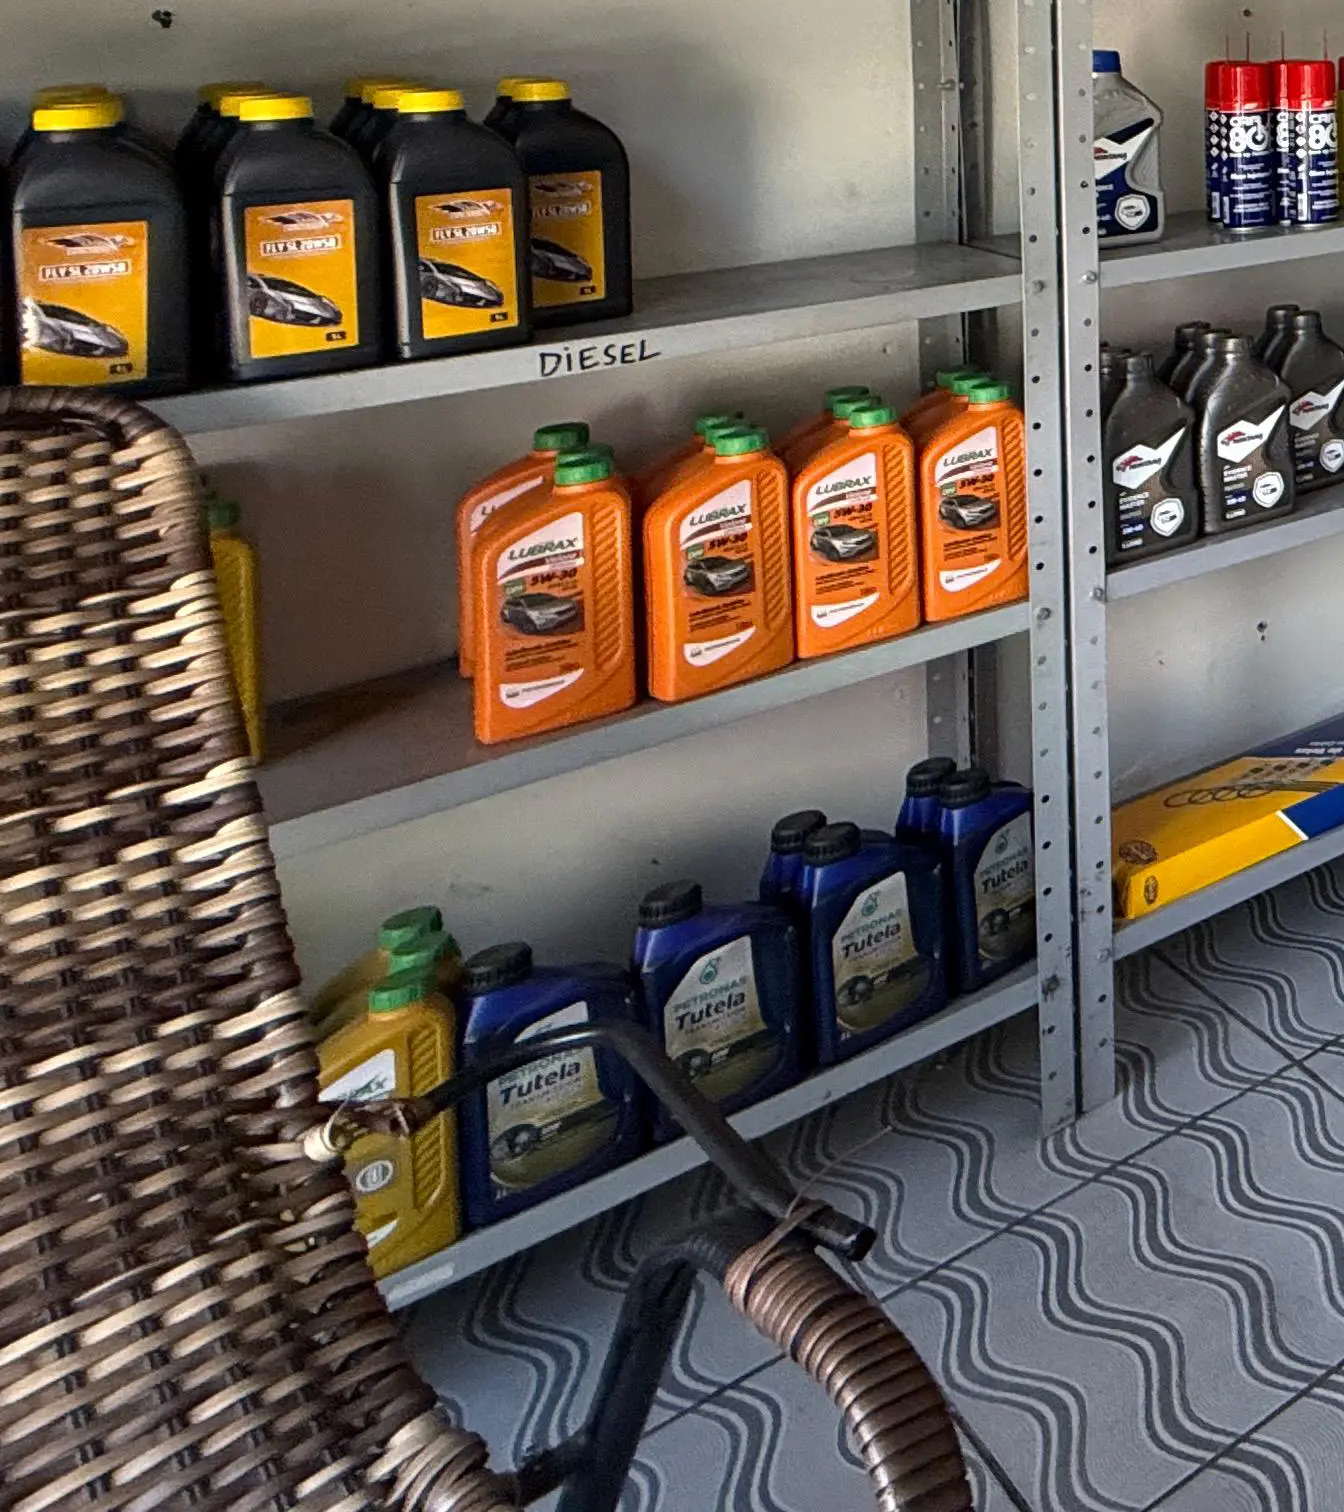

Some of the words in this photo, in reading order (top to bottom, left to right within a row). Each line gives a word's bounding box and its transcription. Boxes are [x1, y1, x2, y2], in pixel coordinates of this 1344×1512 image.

[943, 448, 993, 467] LUBRAX
[816, 476, 873, 496] LUBRAX
[689, 503, 747, 527] LUBRAX
[507, 537, 579, 561] LUBRAX
[981, 859, 1029, 895] Tutela
[842, 923, 901, 959] Tutela
[674, 989, 747, 1033] Tutela
[500, 1060, 582, 1106] Tutela
